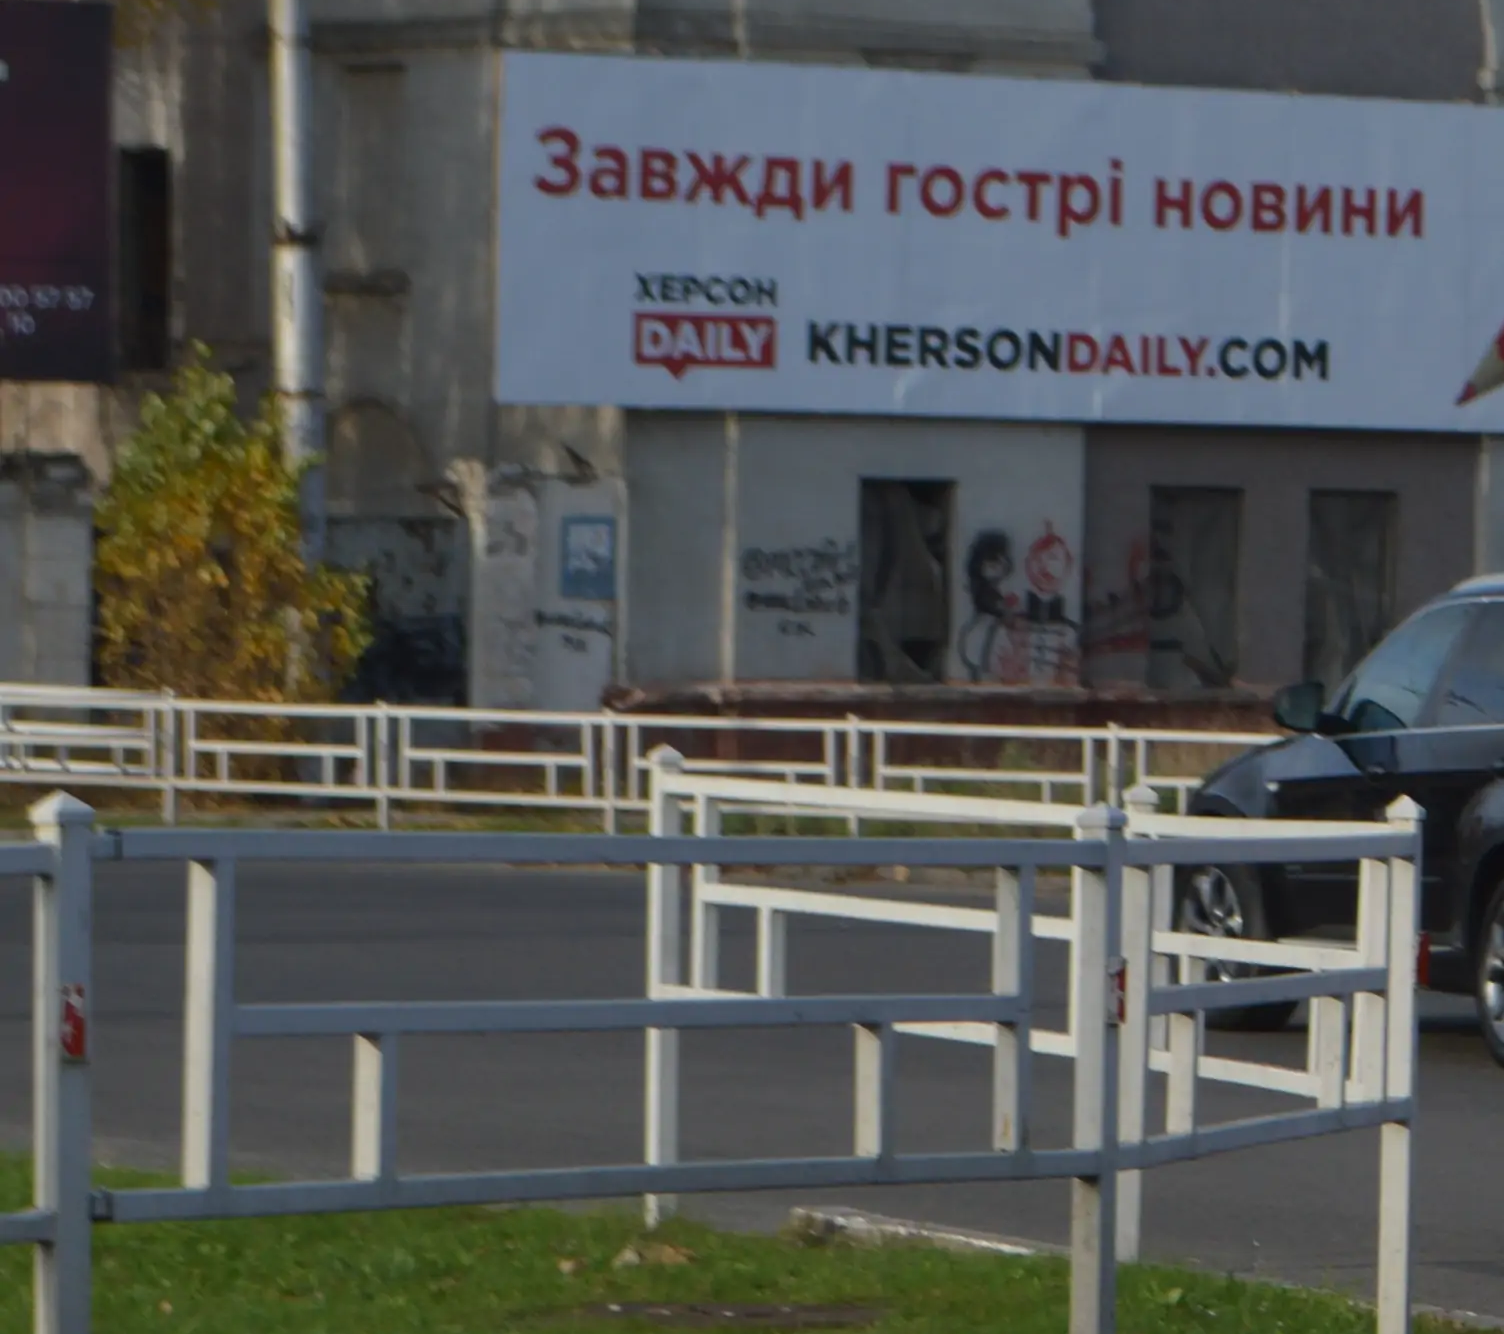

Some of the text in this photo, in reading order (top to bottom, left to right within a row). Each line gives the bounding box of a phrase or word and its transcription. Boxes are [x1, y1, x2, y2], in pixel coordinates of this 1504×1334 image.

[534, 126, 1426, 239] Завжди гострі новини
[634, 273, 779, 307] ХЕРСОН
[640, 317, 771, 363] DAILY
[806, 319, 1330, 381] KHERSONDAILY.COM
